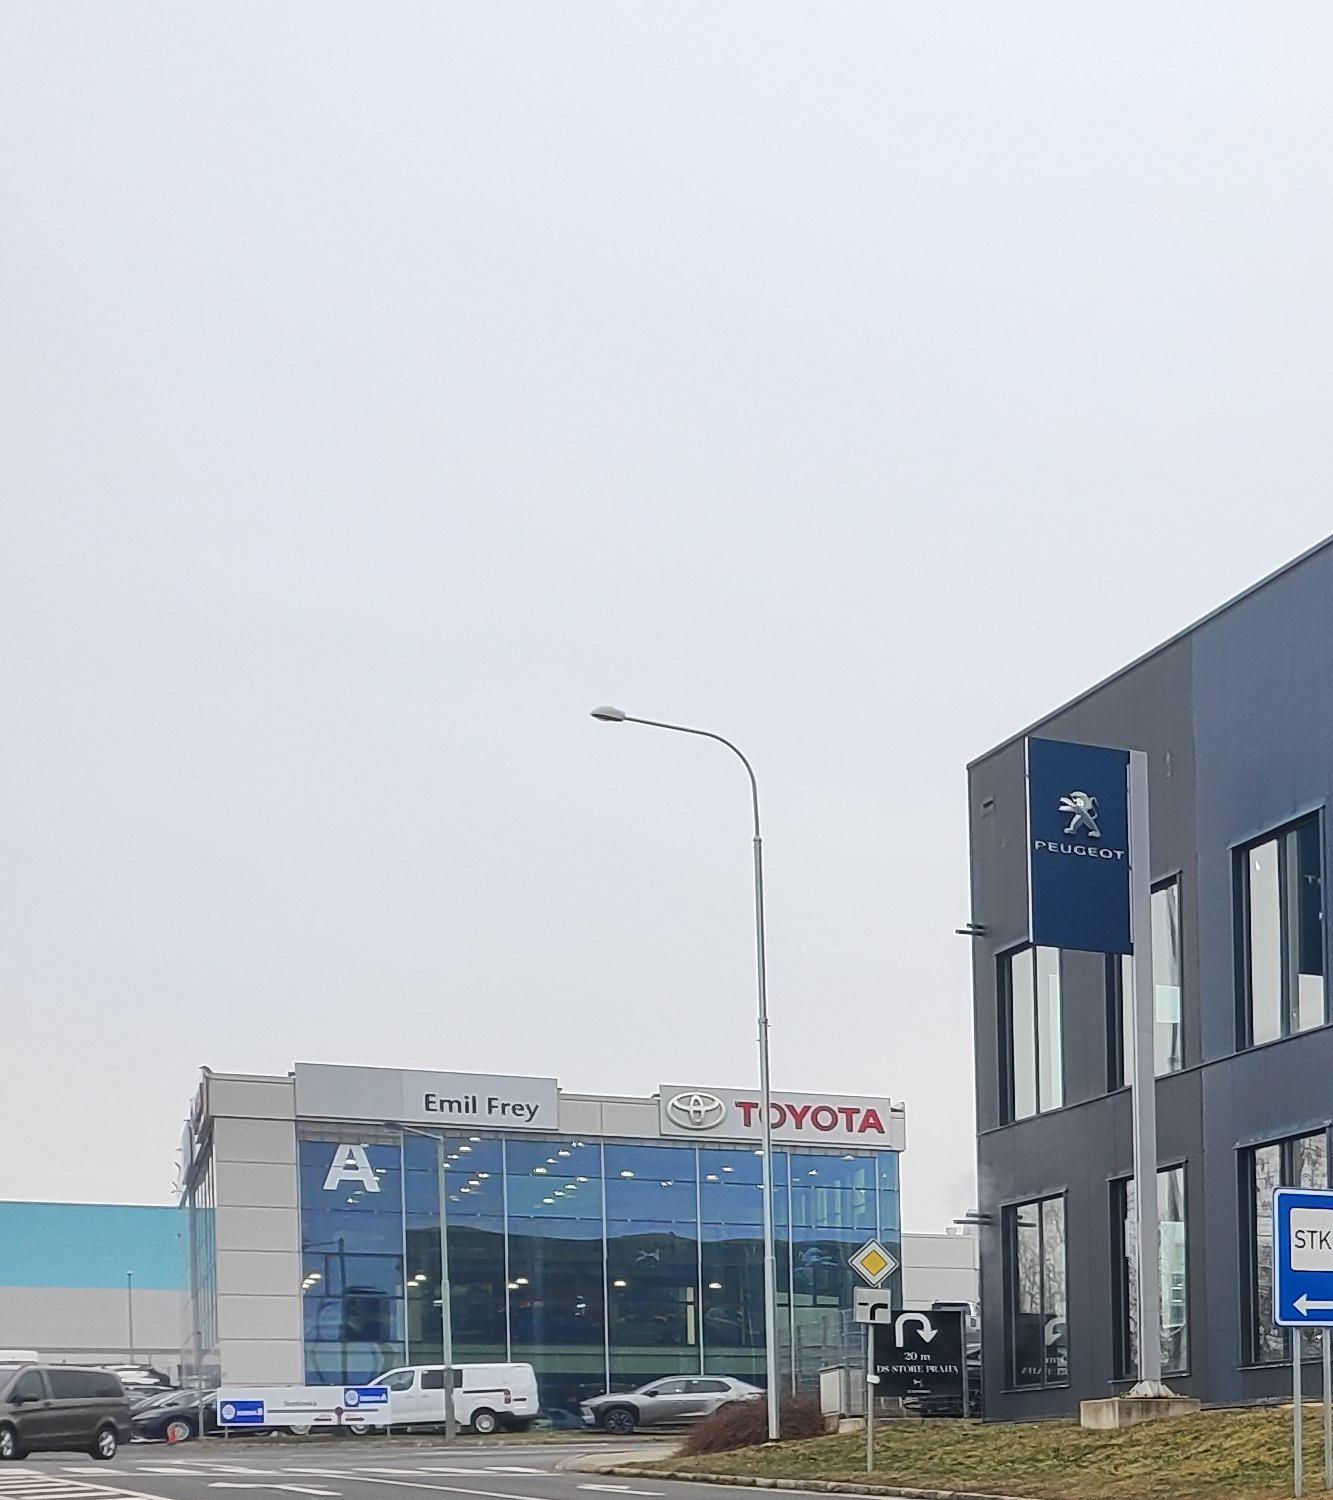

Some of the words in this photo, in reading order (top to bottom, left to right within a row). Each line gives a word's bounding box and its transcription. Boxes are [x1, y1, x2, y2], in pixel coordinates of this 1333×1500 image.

[1034, 840, 1125, 860] PEUGEOT
[424, 1093, 477, 1114] Emil
[487, 1097, 540, 1123] Frey
[734, 1100, 886, 1134] TOYOTA
[1294, 1229, 1332, 1250] STK
[903, 1351, 918, 1361] 20
